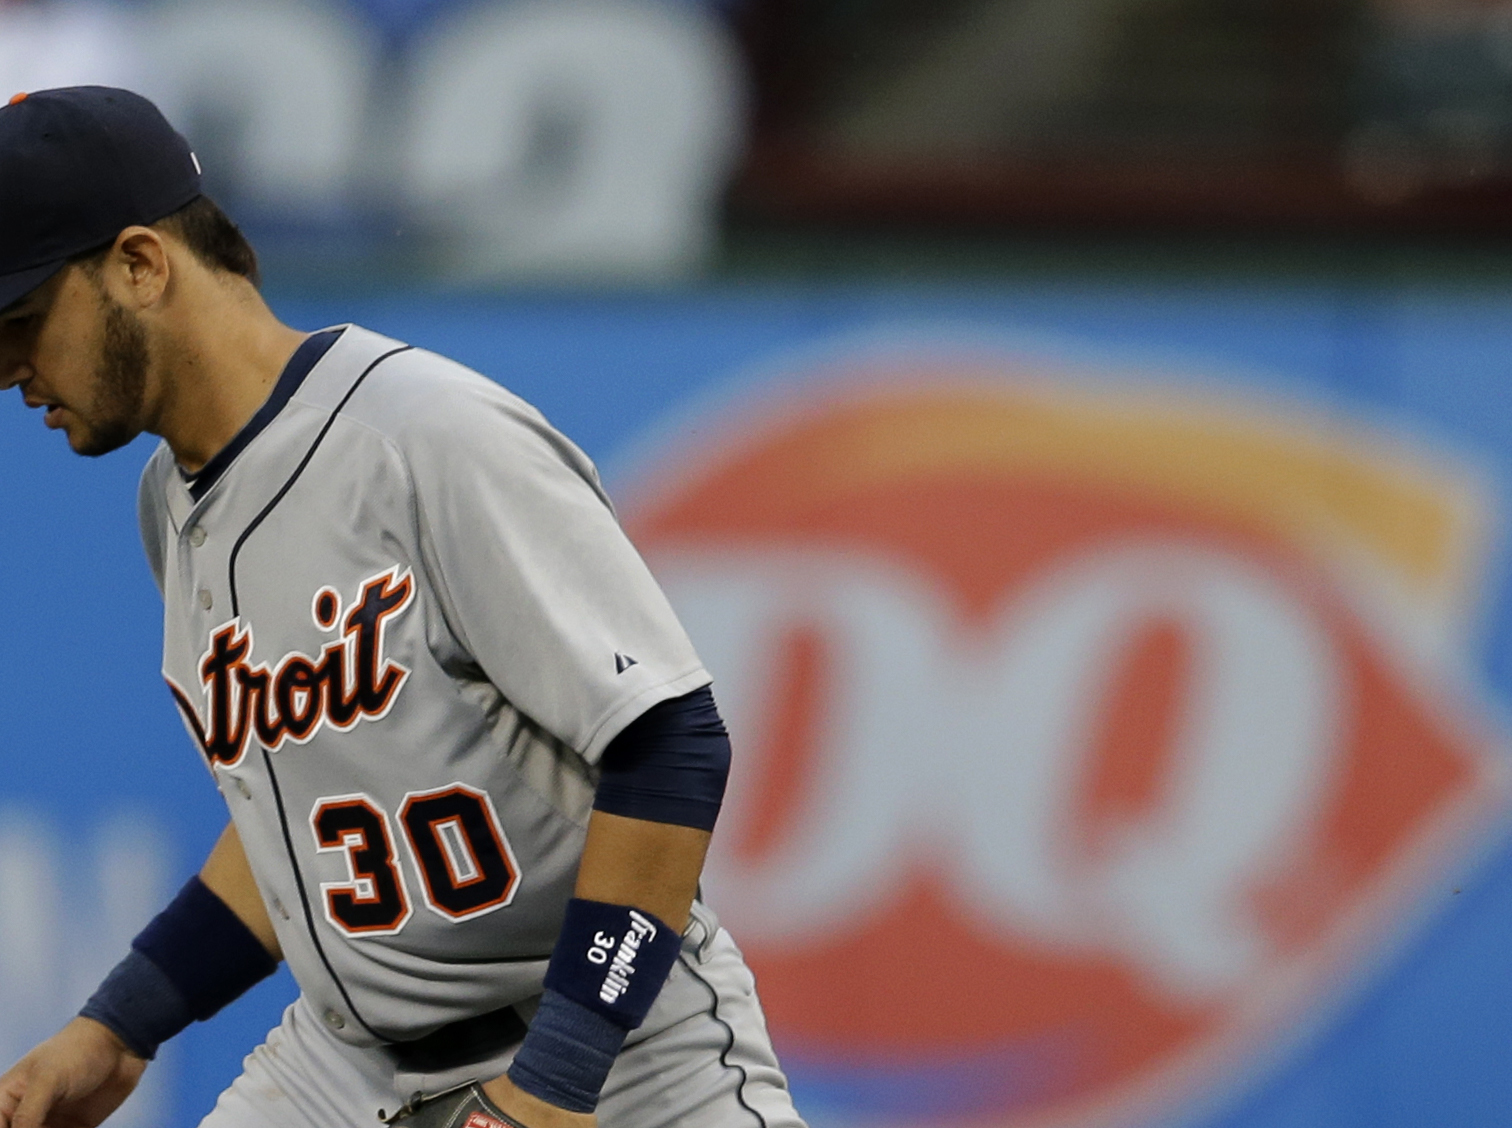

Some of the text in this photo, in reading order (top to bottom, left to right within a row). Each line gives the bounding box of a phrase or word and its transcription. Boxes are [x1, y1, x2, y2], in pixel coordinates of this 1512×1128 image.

[164, 563, 415, 770] troit
[653, 538, 1342, 992] DQ
[310, 781, 522, 937] 30
[586, 930, 616, 965] 30
